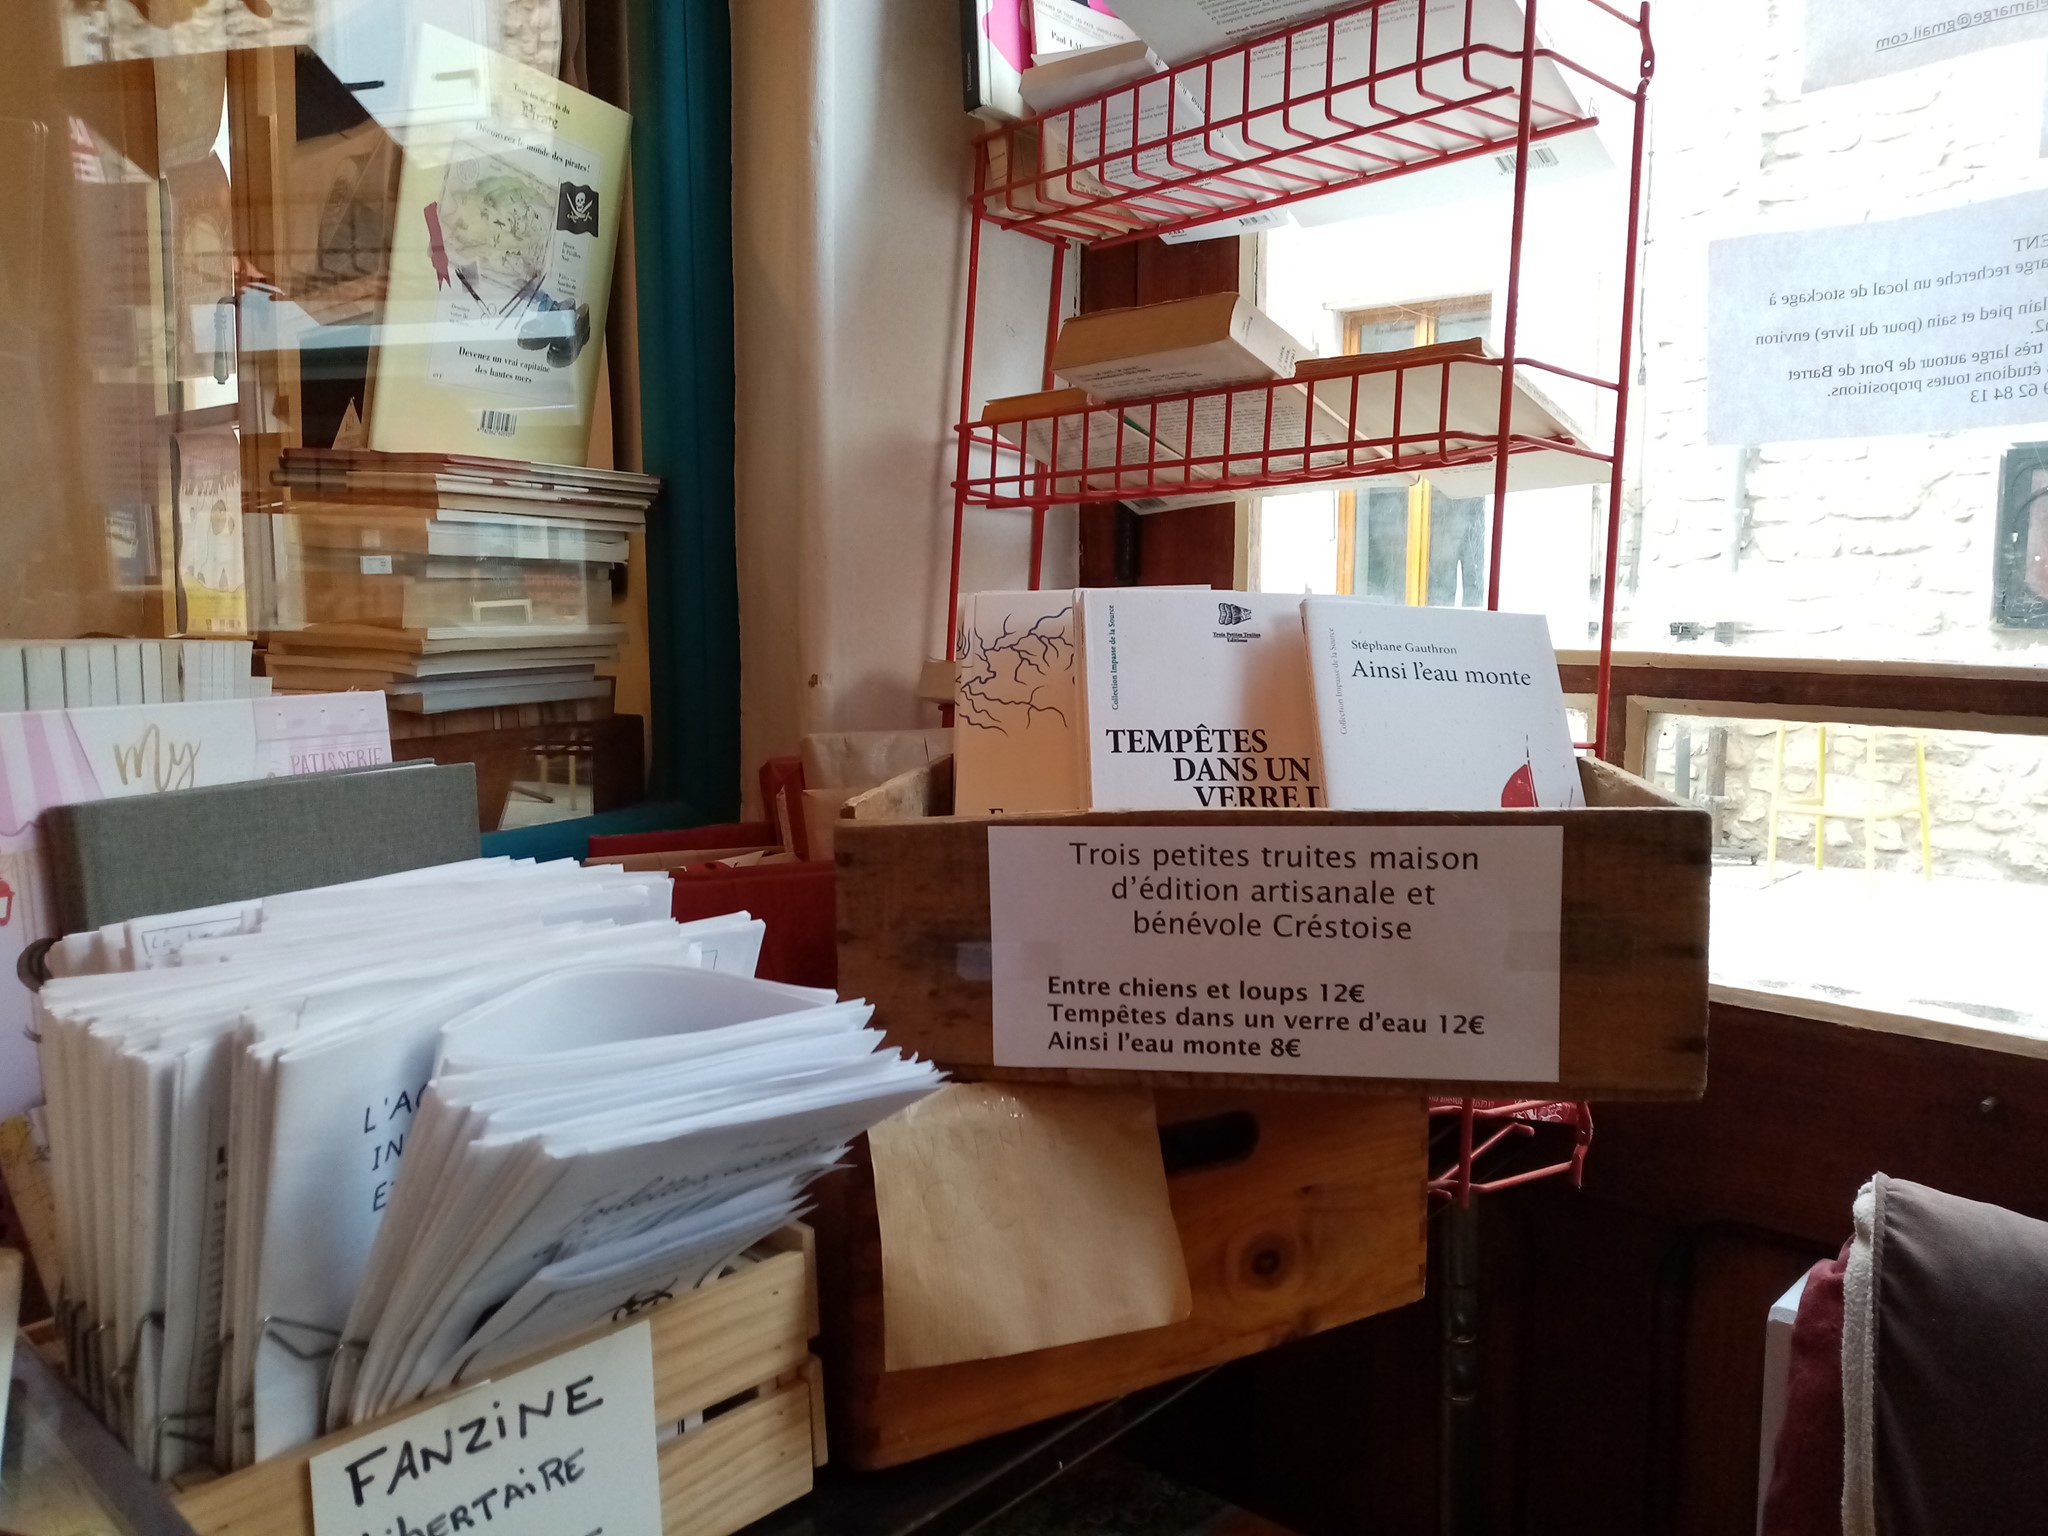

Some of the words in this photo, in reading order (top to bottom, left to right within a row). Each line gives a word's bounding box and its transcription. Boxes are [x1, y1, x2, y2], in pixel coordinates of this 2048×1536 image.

[1051, 30, 1066, 44] Paul
[522, 101, 558, 129] Pirate
[562, 104, 570, 115] du
[475, 122, 516, 145] Découvrez
[517, 137, 524, 146] le
[527, 144, 550, 157] monde
[552, 152, 563, 162] des
[565, 158, 591, 173] pirates!
[459, 346, 490, 361] Devenez
[504, 357, 518, 366] vrai
[520, 361, 550, 372] capitaine
[475, 365, 488, 375] des
[489, 368, 514, 380] hautes
[515, 375, 532, 383] mers
[1110, 636, 1116, 645] de
[1352, 640, 1402, 653] Stéphane
[1405, 643, 1458, 655] Gauthron
[1332, 660, 1339, 669] de
[1352, 661, 1408, 679] Ainsi
[1466, 669, 1532, 686] monte
[1338, 698, 1347, 735] Collection
[1105, 724, 1268, 753] TEMPÊTES
[290, 745, 384, 776] PATISSERIE
[1172, 757, 1260, 782] DANS
[1263, 758, 1311, 782] UN
[1192, 785, 1300, 807] VERRE
[1069, 841, 1141, 868] Trois
[1152, 843, 1251, 876] petites
[1261, 846, 1357, 871] truites
[1369, 848, 1480, 872] maison
[1251, 879, 1395, 906] artisanale
[1407, 884, 1436, 907] et
[1134, 910, 1262, 938] bénévole
[1273, 914, 1412, 942] Créstoise
[1047, 976, 1111, 997] Entre
[1118, 977, 1197, 1000] chiens
[1206, 981, 1231, 1002] et
[1239, 982, 1308, 1009] loups
[1319, 982, 1365, 1004] 12€
[1047, 1004, 1166, 1032] Tempêtes
[1175, 1006, 1234, 1028] dans
[1244, 1011, 1275, 1029] un
[1284, 1013, 1349, 1033] verre
[1437, 1013, 1485, 1036] 12€
[1047, 1031, 1111, 1051] Ainsi
[1183, 1036, 1262, 1057] monte
[1270, 1037, 1302, 1058] 8€
